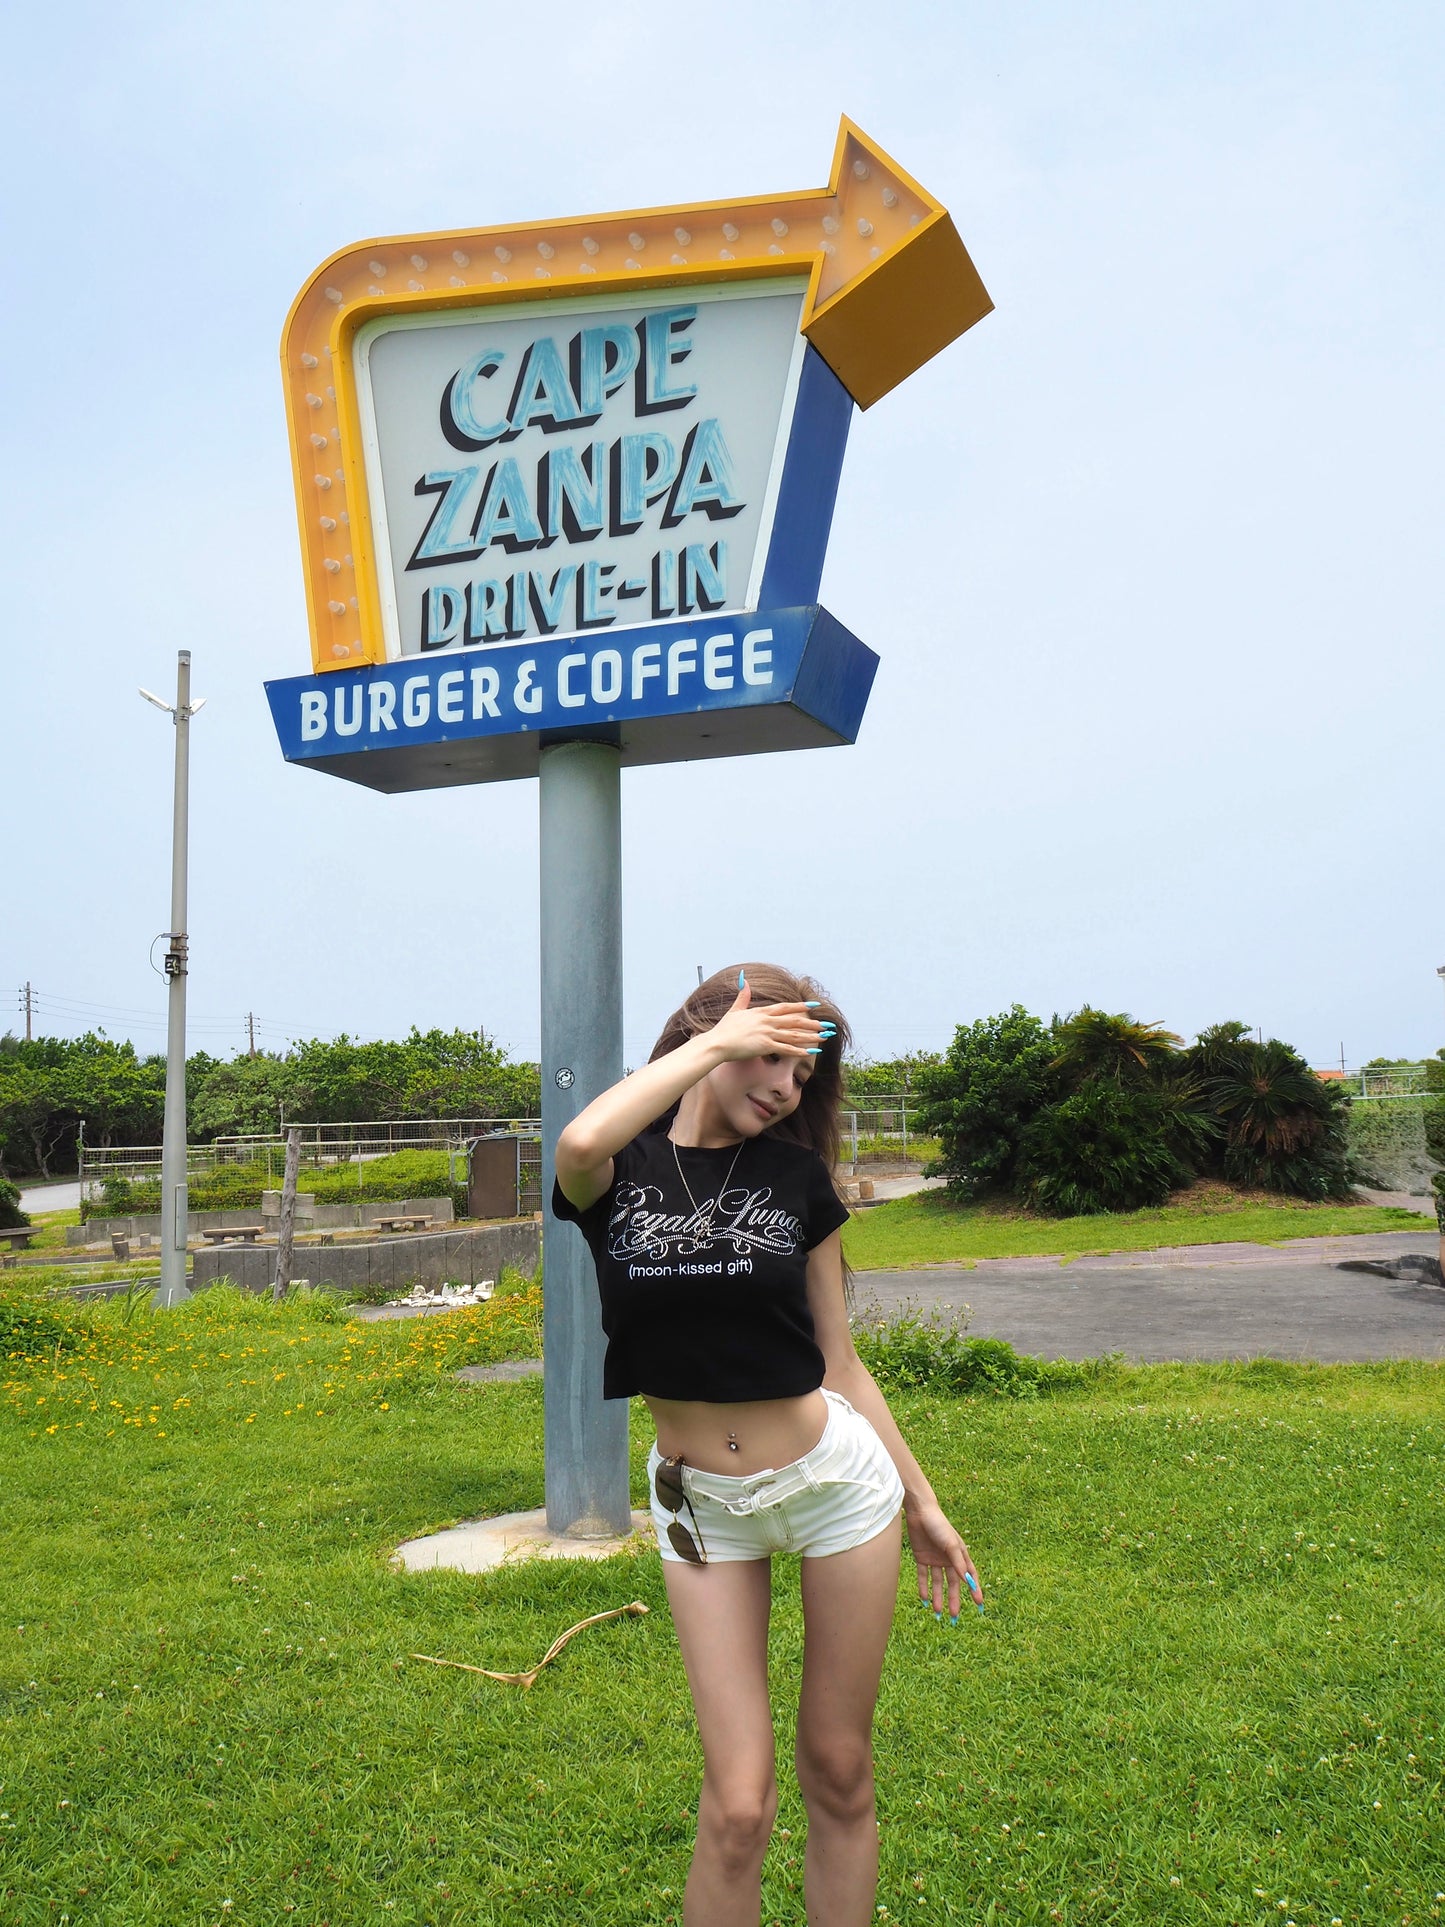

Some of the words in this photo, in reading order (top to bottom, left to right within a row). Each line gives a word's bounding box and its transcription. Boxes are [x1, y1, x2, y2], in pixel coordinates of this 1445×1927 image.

[440, 305, 699, 452] CAPE
[404, 417, 747, 570] ZANPA
[421, 540, 728, 651] DRIVE-IN
[299, 667, 502, 742] BURGER
[513, 659, 544, 714] &
[556, 628, 775, 709] COFFEE
[628, 1261, 722, 1280] (moon-kissed
[727, 1258, 753, 1275] gift)
[718, 1186, 804, 1252] Luna
